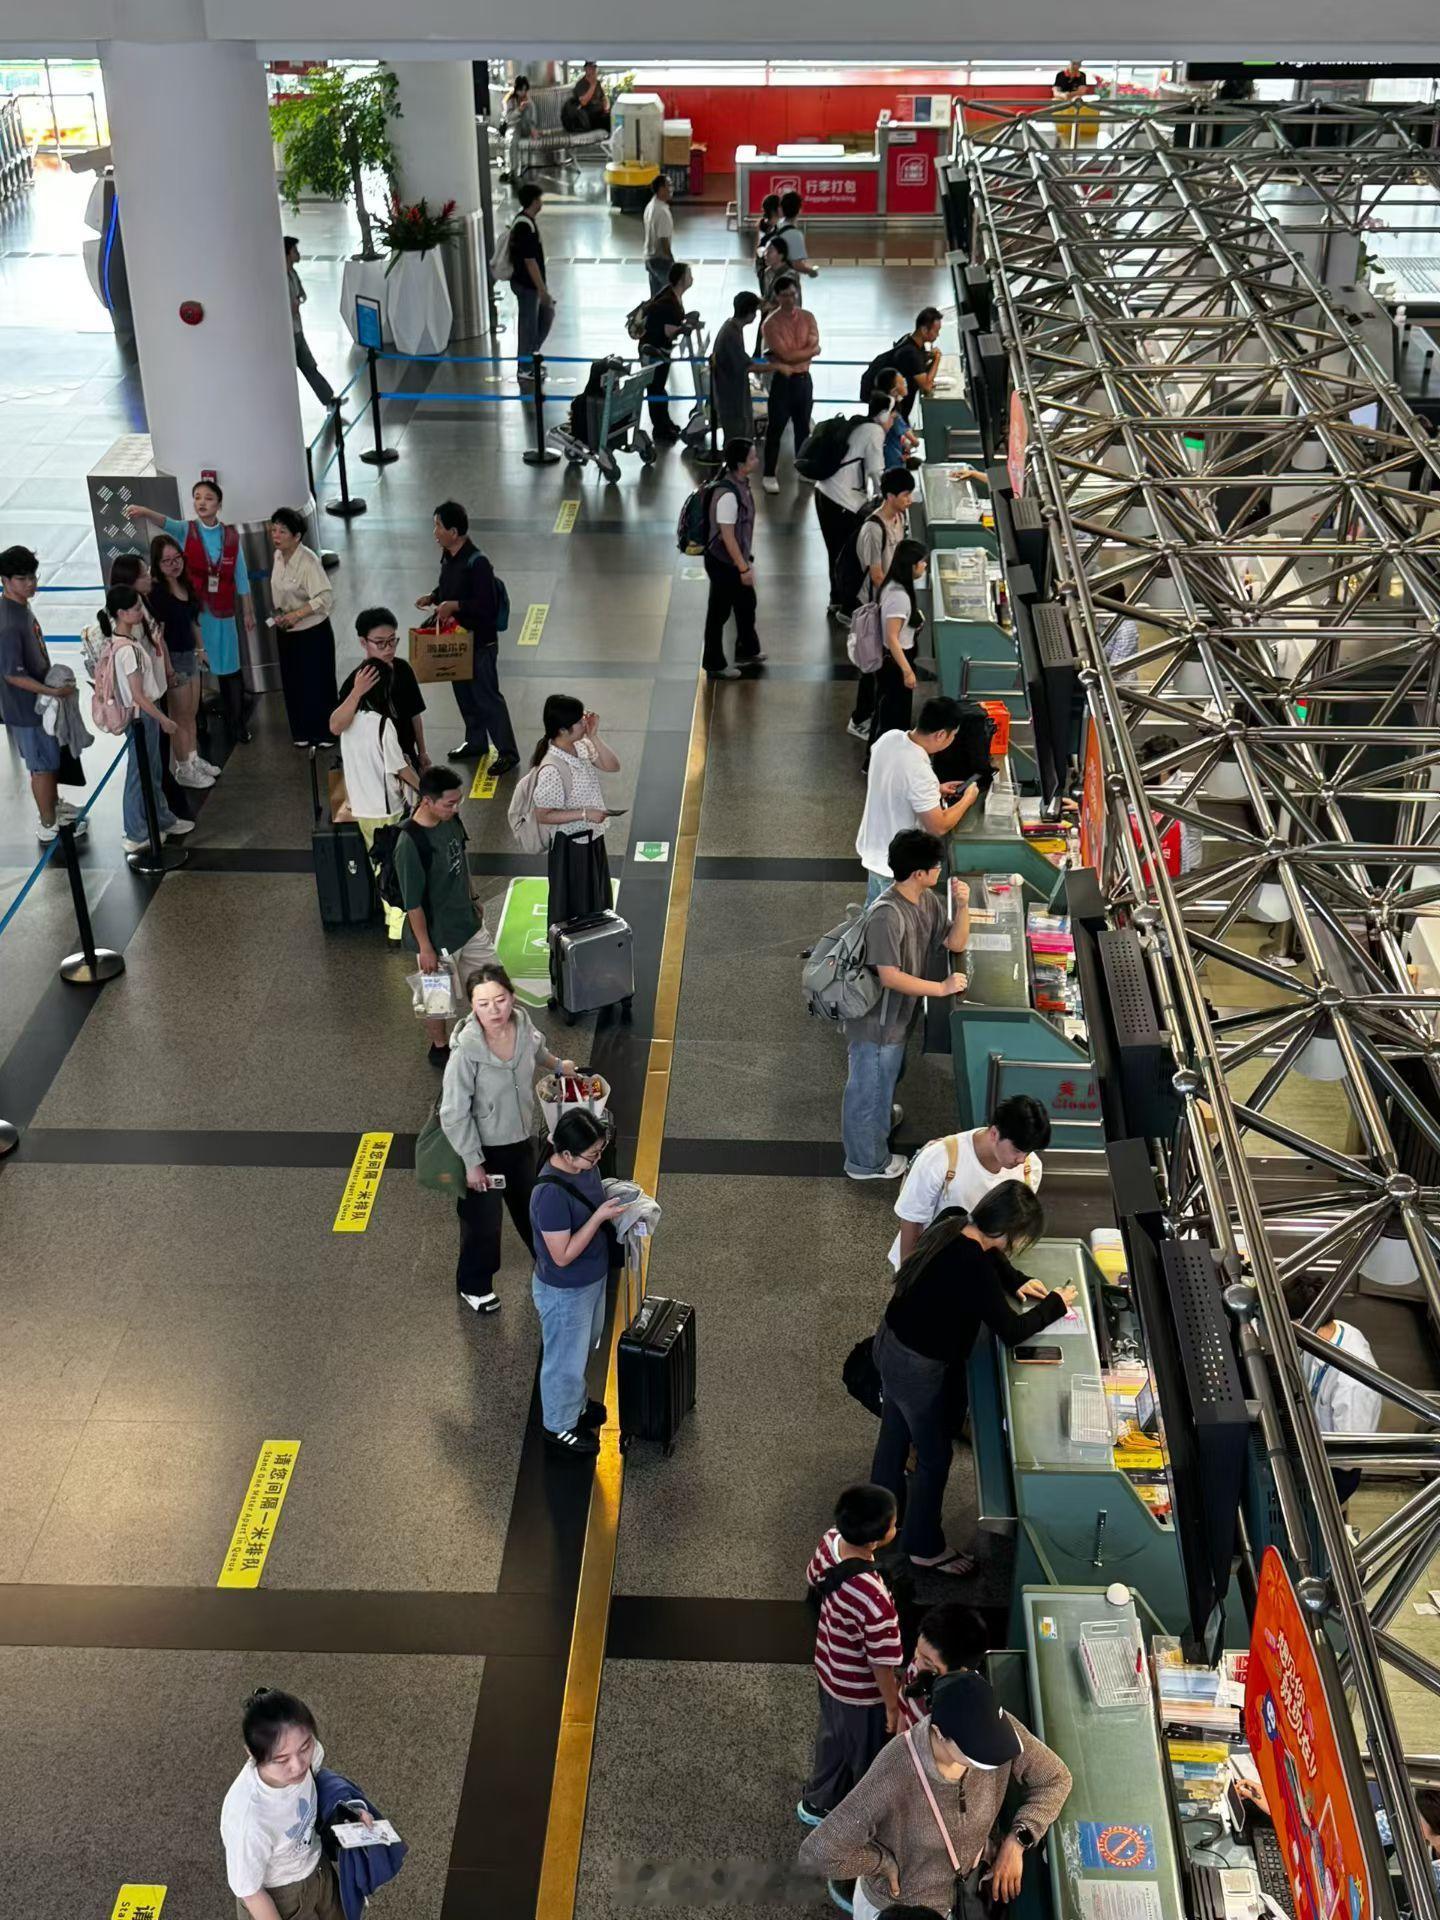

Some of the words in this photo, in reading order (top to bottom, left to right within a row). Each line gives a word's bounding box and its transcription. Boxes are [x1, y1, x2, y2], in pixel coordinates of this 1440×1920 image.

[805, 180, 856, 194] 行李打包
[351, 1141, 387, 1221] 请您间隔一米排队
[260, 1451, 272, 1471] Stand
[254, 1473, 265, 1487] One
[249, 1490, 260, 1512] Meter
[240, 1453, 293, 1571] 请您间隔一米排队
[240, 1514, 252, 1534] Apart
[227, 1547, 241, 1572] Queue
